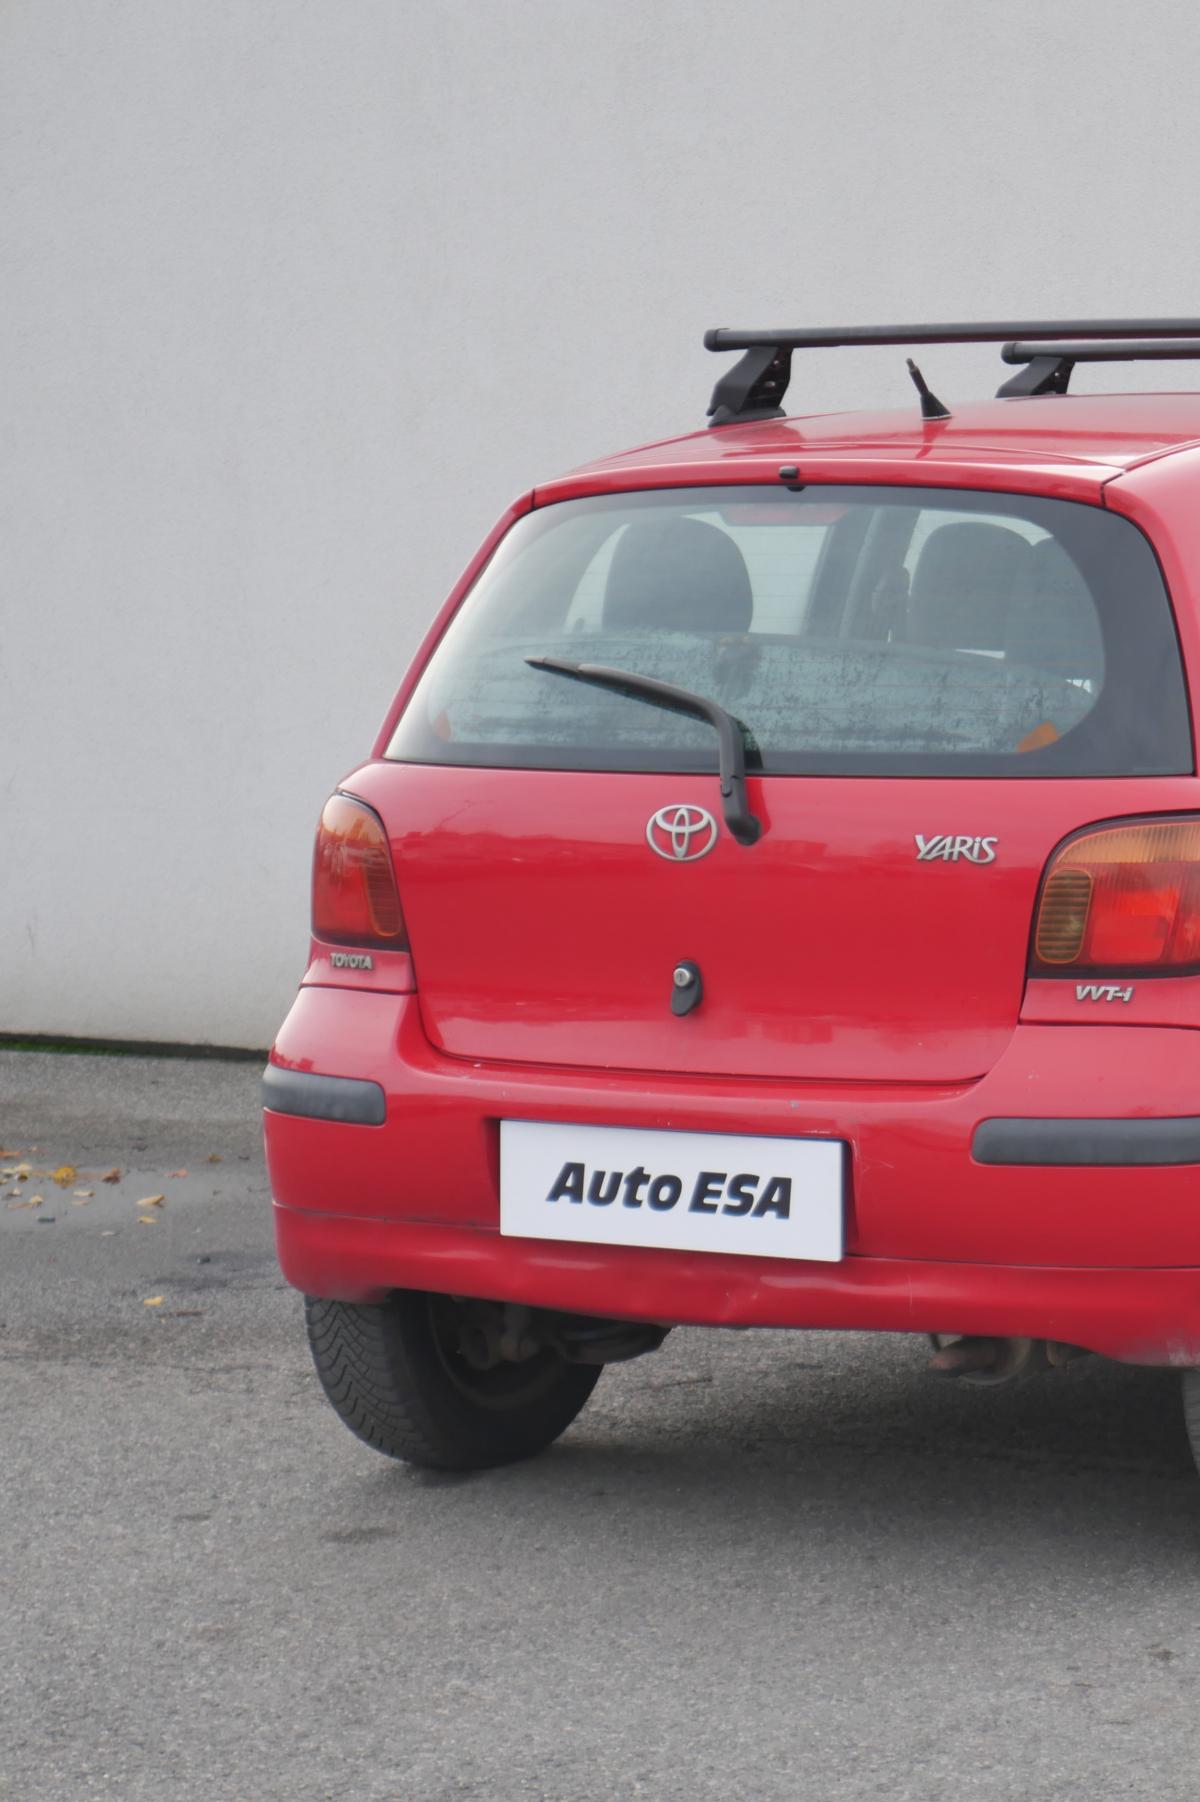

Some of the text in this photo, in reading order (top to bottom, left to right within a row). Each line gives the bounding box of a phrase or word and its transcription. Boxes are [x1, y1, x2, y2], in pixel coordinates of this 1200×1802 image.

[330, 952, 374, 970] TOYOTA
[545, 1161, 793, 1221] Auto ESA
